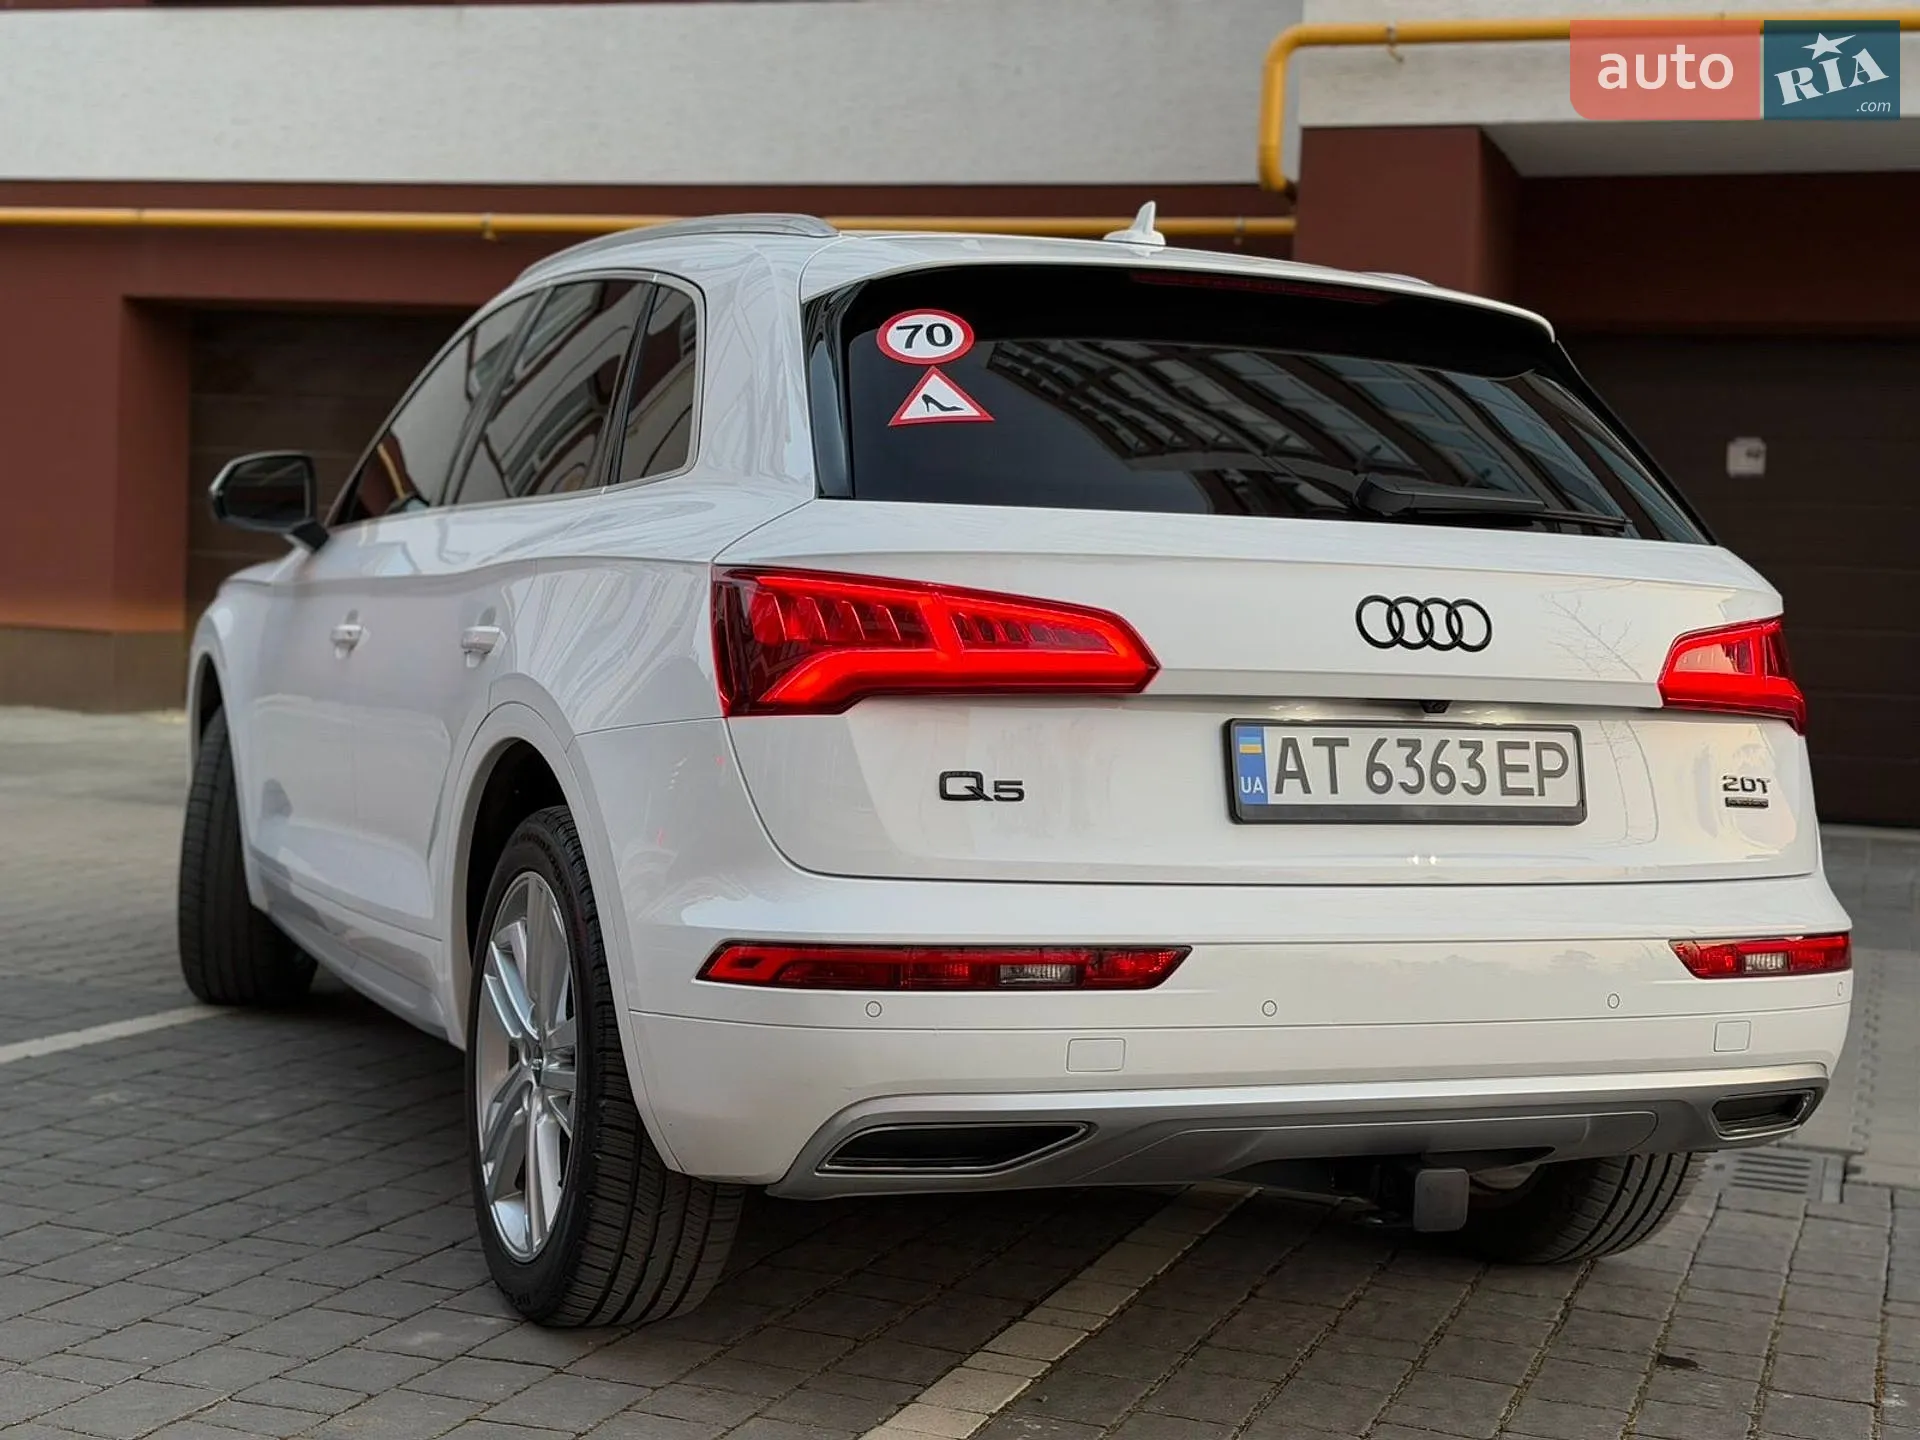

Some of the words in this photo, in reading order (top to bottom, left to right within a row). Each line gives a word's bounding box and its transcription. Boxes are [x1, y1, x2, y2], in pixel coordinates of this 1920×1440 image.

[896, 323, 953, 349] 70
[1274, 737, 1349, 795] AT
[1365, 737, 1487, 796] 6363
[1497, 740, 1569, 797] EP
[939, 770, 1025, 802] Q5
[1241, 776, 1264, 793] UA
